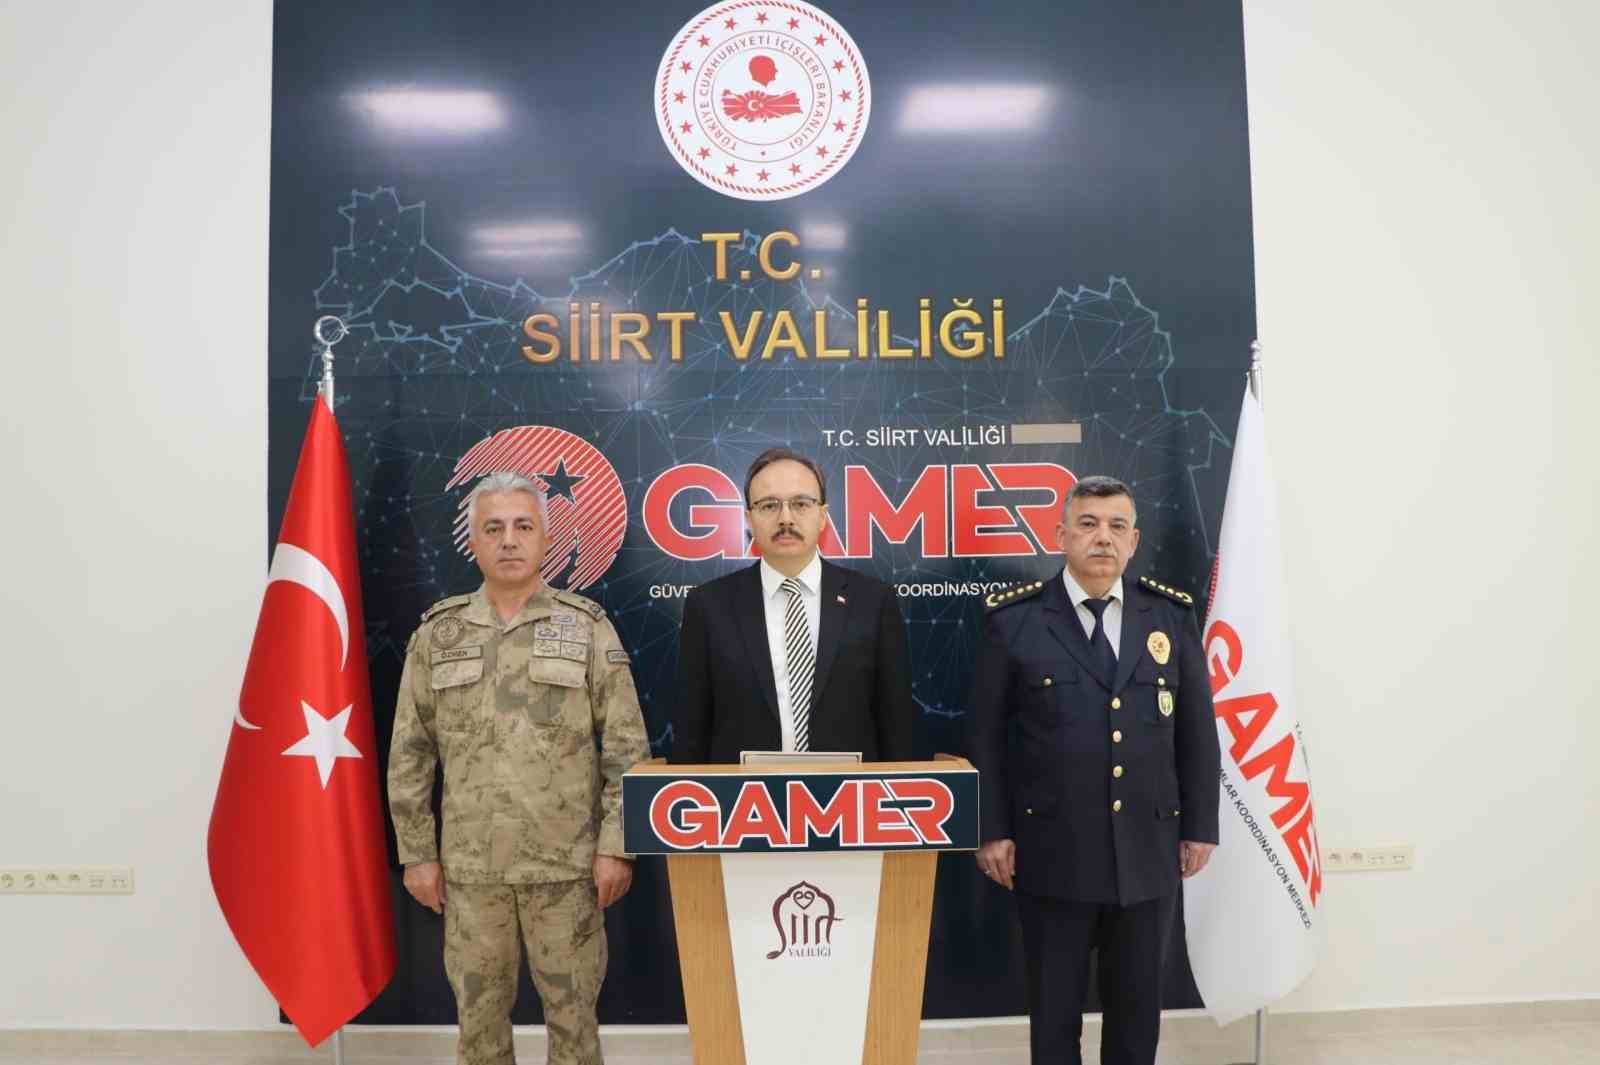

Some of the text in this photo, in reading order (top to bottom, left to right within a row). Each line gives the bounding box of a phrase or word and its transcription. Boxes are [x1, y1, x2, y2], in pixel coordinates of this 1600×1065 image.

[702, 229, 822, 281] T.C.
[521, 298, 1005, 363] SİİRT VALİLİĞİ
[822, 425, 1006, 447] T.C. SİİRT VALİLİĞİ
[649, 778, 955, 850] GAMER
